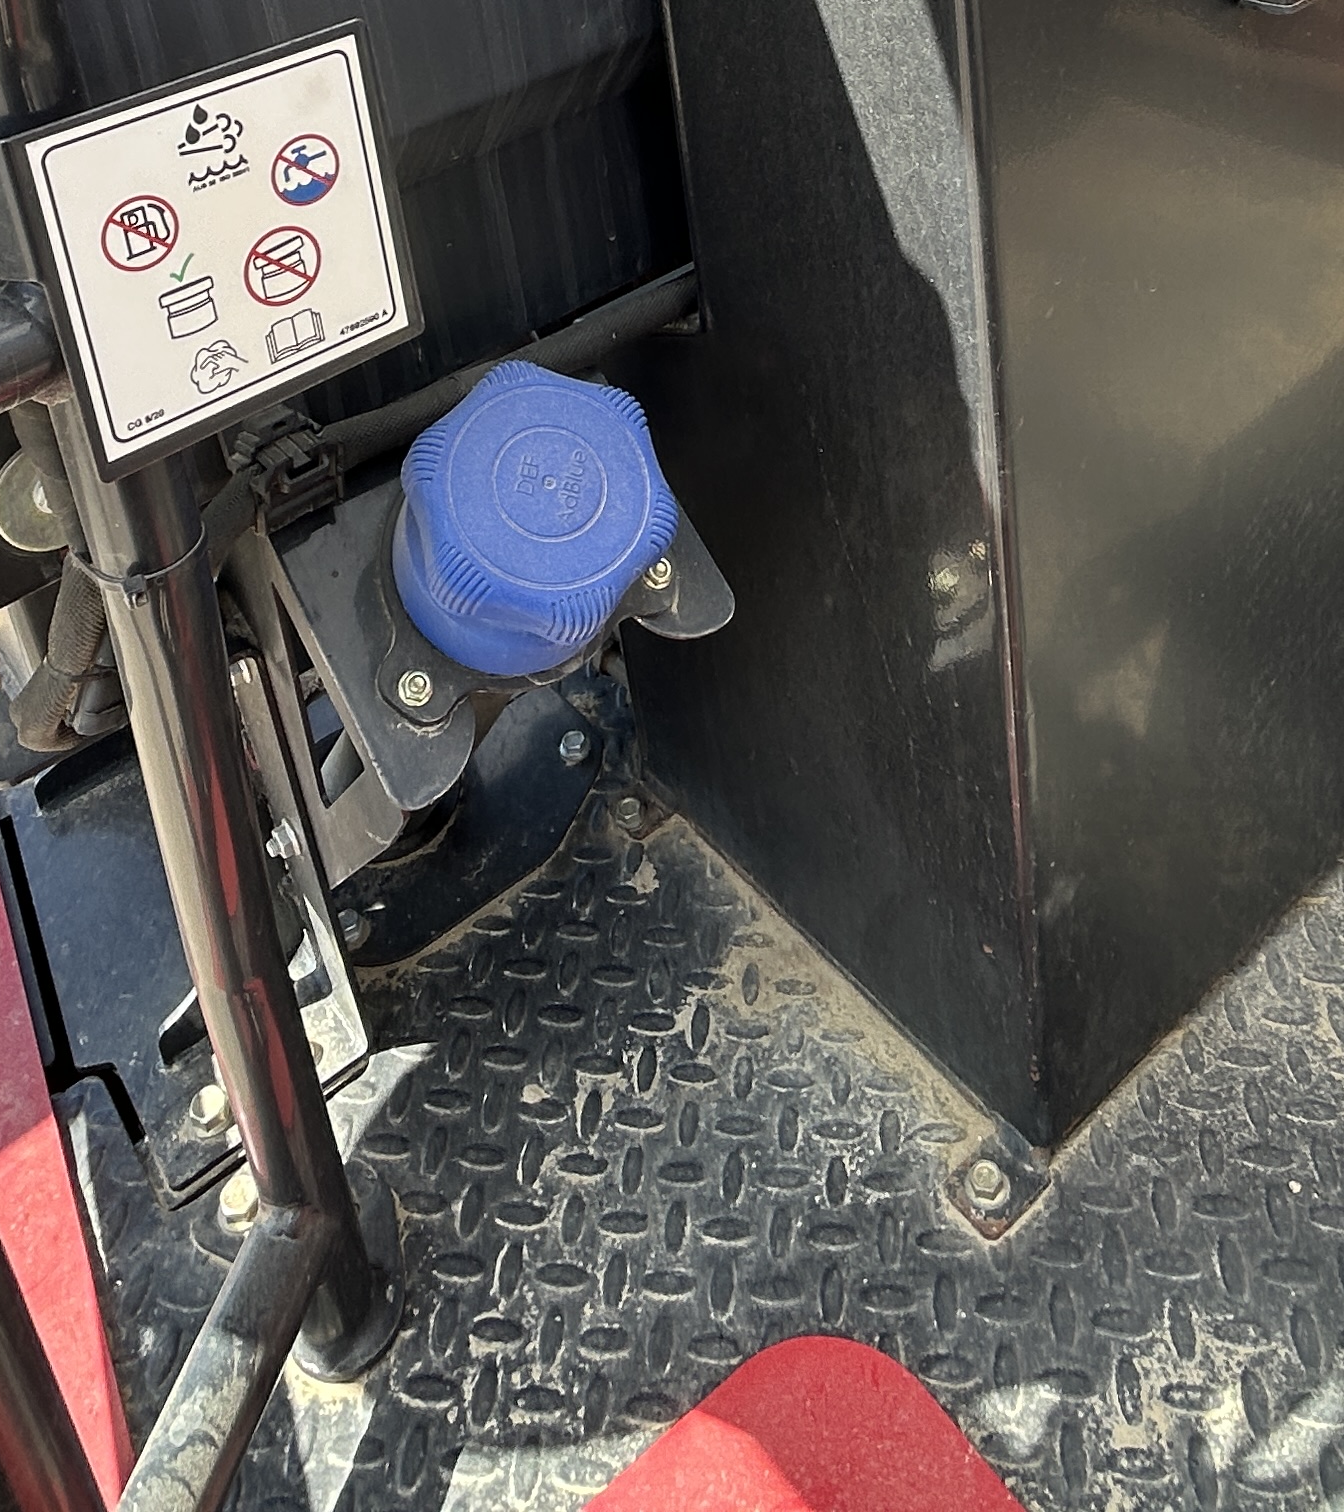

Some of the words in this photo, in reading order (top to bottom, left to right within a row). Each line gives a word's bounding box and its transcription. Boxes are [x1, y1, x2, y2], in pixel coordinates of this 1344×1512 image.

[381, 308, 389, 318] A
[516, 454, 539, 497] DEF
[556, 448, 587, 528] AdBlue
